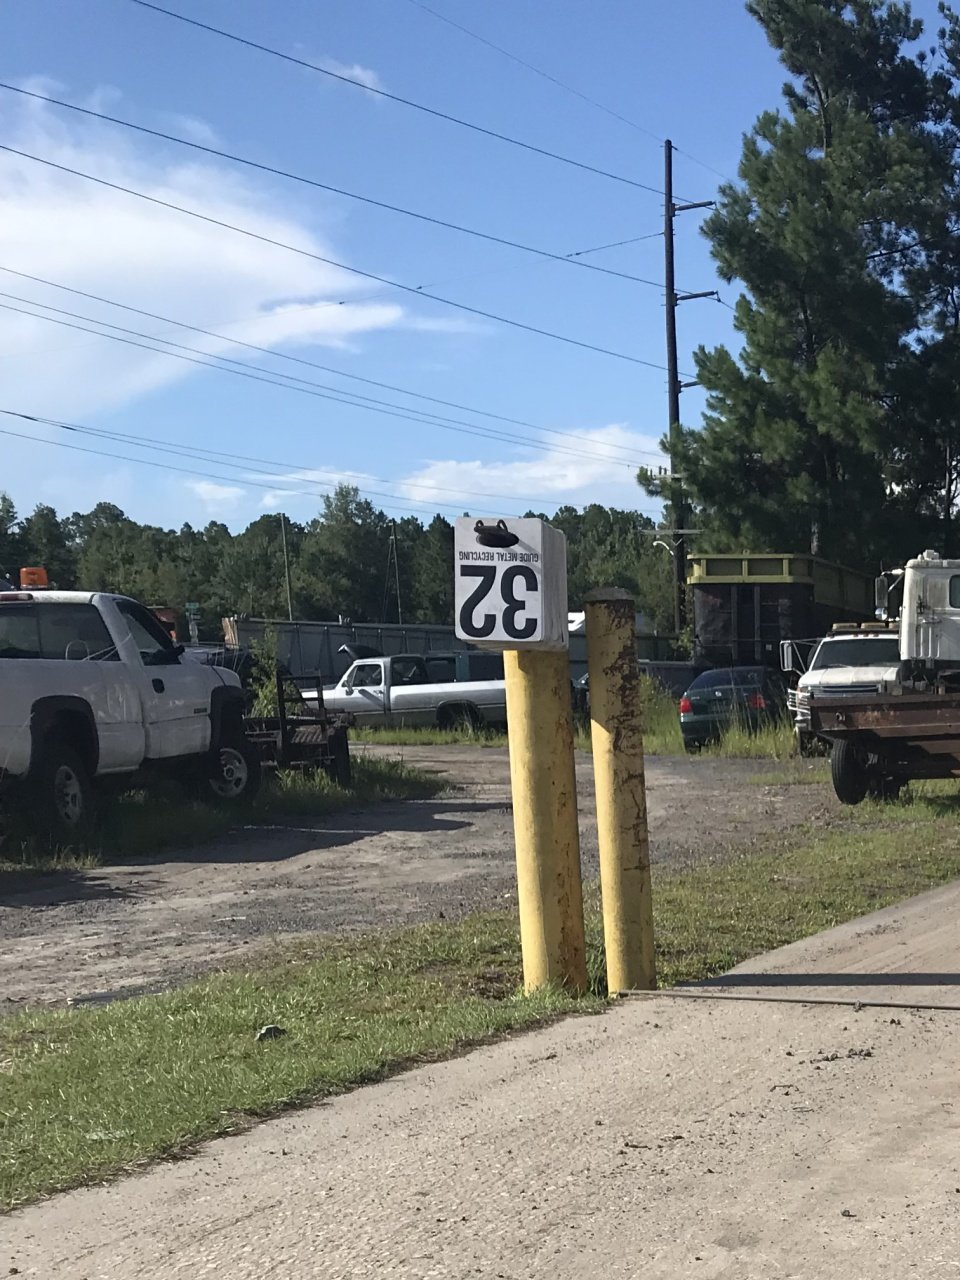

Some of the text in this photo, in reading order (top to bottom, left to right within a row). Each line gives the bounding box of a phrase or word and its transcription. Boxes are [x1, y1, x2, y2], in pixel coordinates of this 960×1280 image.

[458, 550, 539, 563] GUIDE METAL RECYCLING
[459, 564, 539, 640] 32
